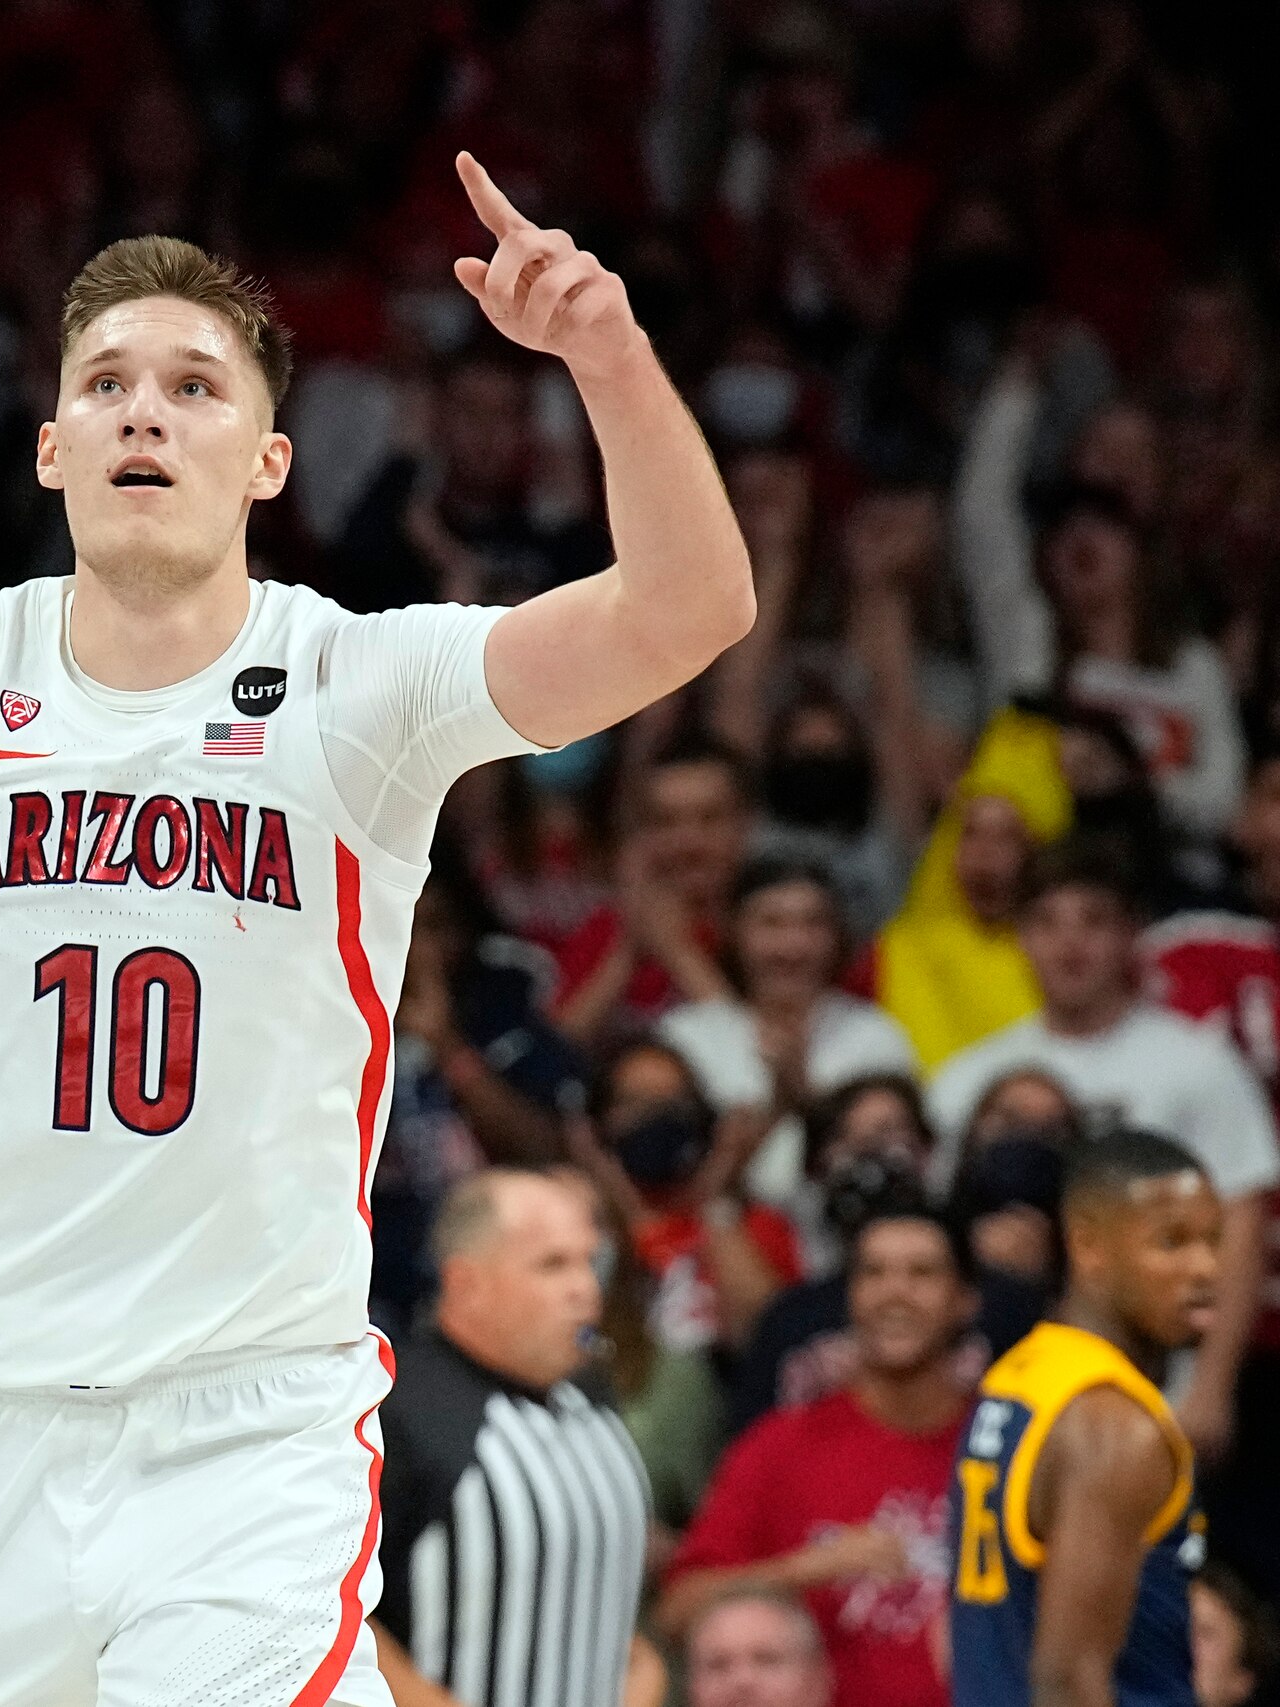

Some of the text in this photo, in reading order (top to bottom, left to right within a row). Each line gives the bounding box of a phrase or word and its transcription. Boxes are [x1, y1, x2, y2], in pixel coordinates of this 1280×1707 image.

[237, 680, 286, 700] LUTE
[2, 690, 40, 719] PAC
[5, 705, 25, 724] 12
[33, 943, 202, 1137] 10
